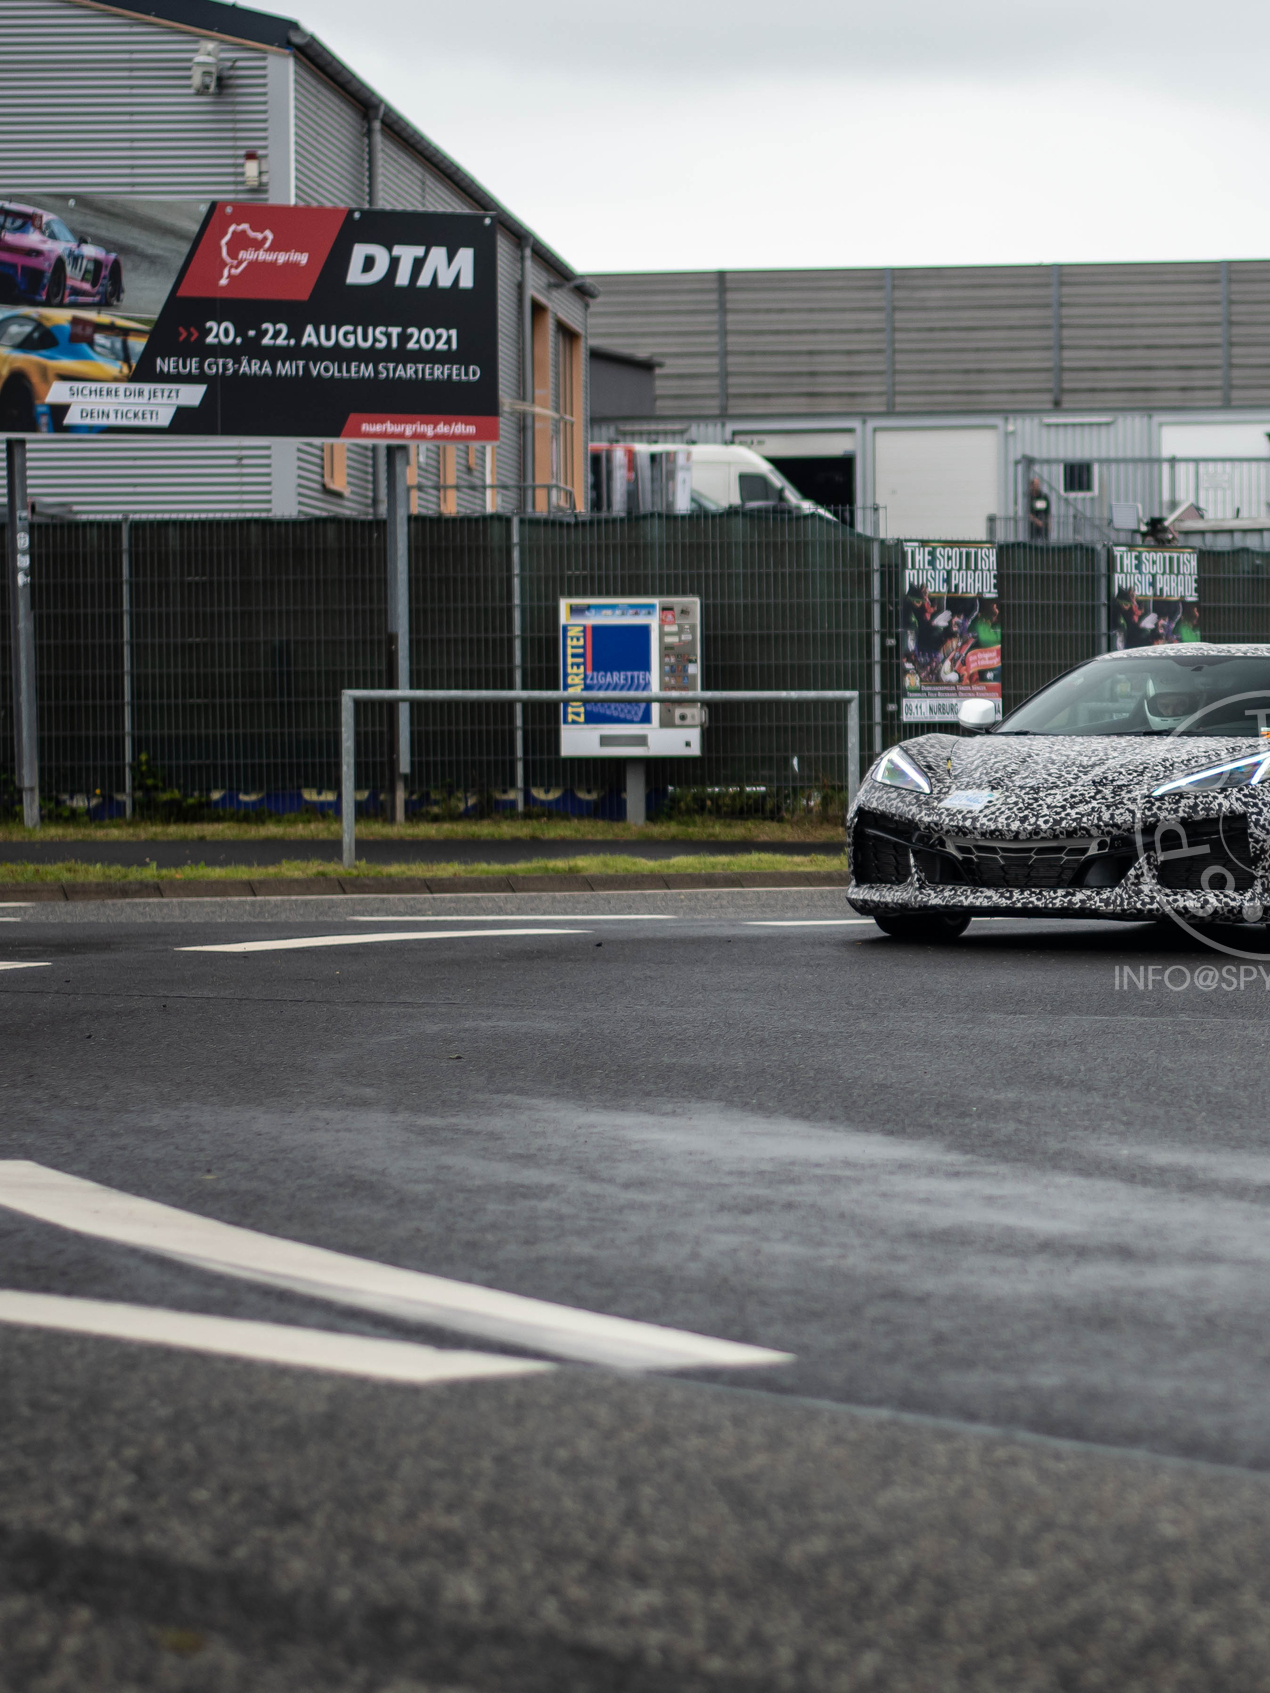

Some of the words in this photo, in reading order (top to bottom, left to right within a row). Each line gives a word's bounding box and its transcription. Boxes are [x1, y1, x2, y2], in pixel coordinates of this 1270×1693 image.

[238, 248, 309, 266] nürburgring
[346, 243, 474, 289] DTM
[205, 321, 242, 345] 20.
[261, 323, 295, 346] 22.
[301, 324, 402, 350] AUGUST
[406, 328, 457, 351] 2021
[156, 357, 200, 376] NEUE
[204, 356, 272, 377] GT3-ÄRA
[276, 360, 306, 377] MIT
[309, 361, 374, 379] VOLLEM
[378, 363, 481, 382] STARTERFELD
[69, 386, 121, 398] SICHERE
[124, 387, 146, 399] DIR
[148, 388, 181, 401] JETZT
[80, 408, 110, 420] DEIN
[113, 409, 159, 421] TICKET!
[361, 420, 476, 438] nuerburgring.de/dtm
[904, 547, 933, 569] THE
[936, 547, 997, 570] SCOTTISH
[1114, 551, 1139, 573] THE
[1142, 552, 1198, 575] SCOTTISH
[905, 570, 947, 594] MUSIC
[951, 570, 998, 595] PARADE
[1114, 573, 1153, 597] MUSIC
[1156, 574, 1199, 598] PARADE
[567, 626, 585, 723] ZIARETTEN
[586, 671, 652, 685] ZIGARETTEN
[905, 703, 926, 716] 09.11.
